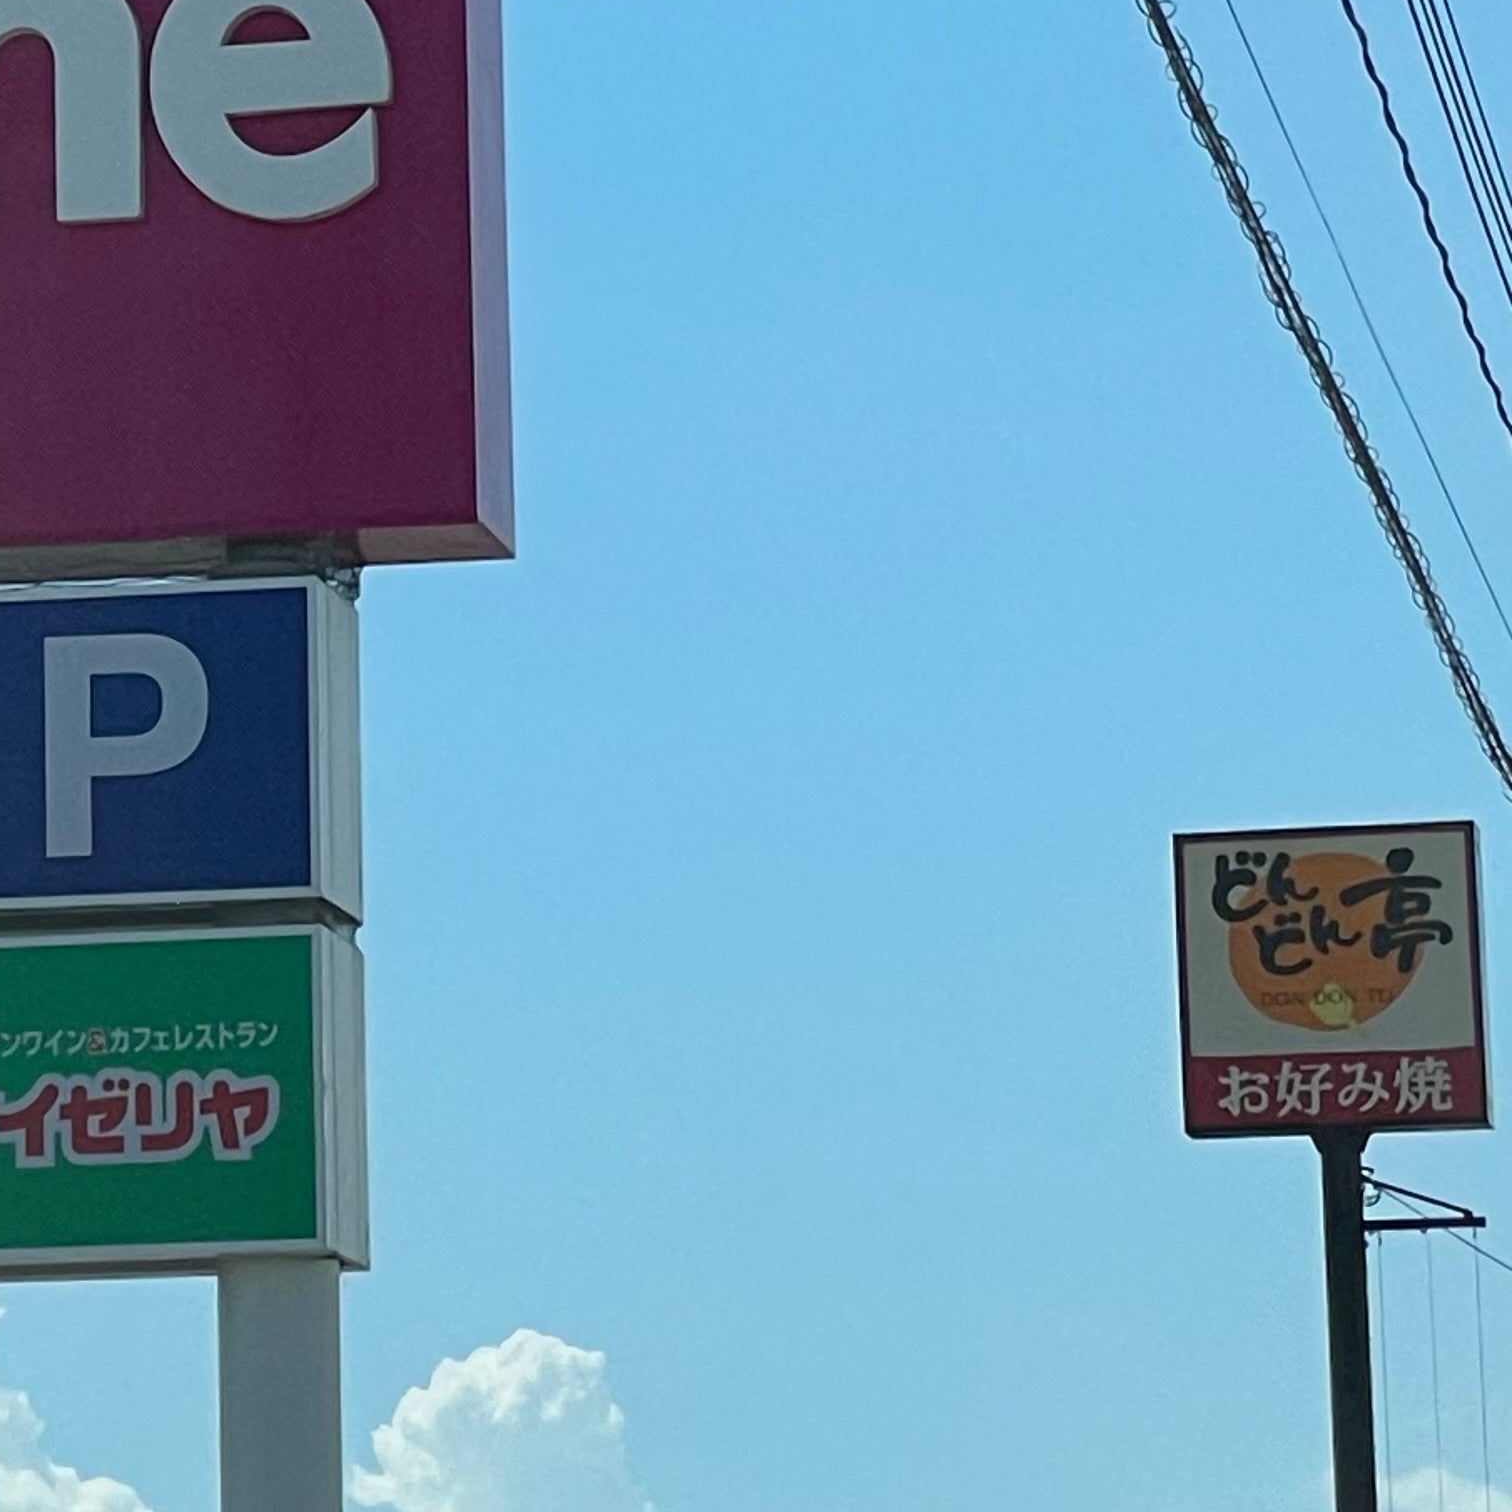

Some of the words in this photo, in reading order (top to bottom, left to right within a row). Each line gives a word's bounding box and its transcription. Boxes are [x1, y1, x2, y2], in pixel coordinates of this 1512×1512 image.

[44, 633, 209, 858] P
[1218, 1056, 1454, 1117] お好み焼
